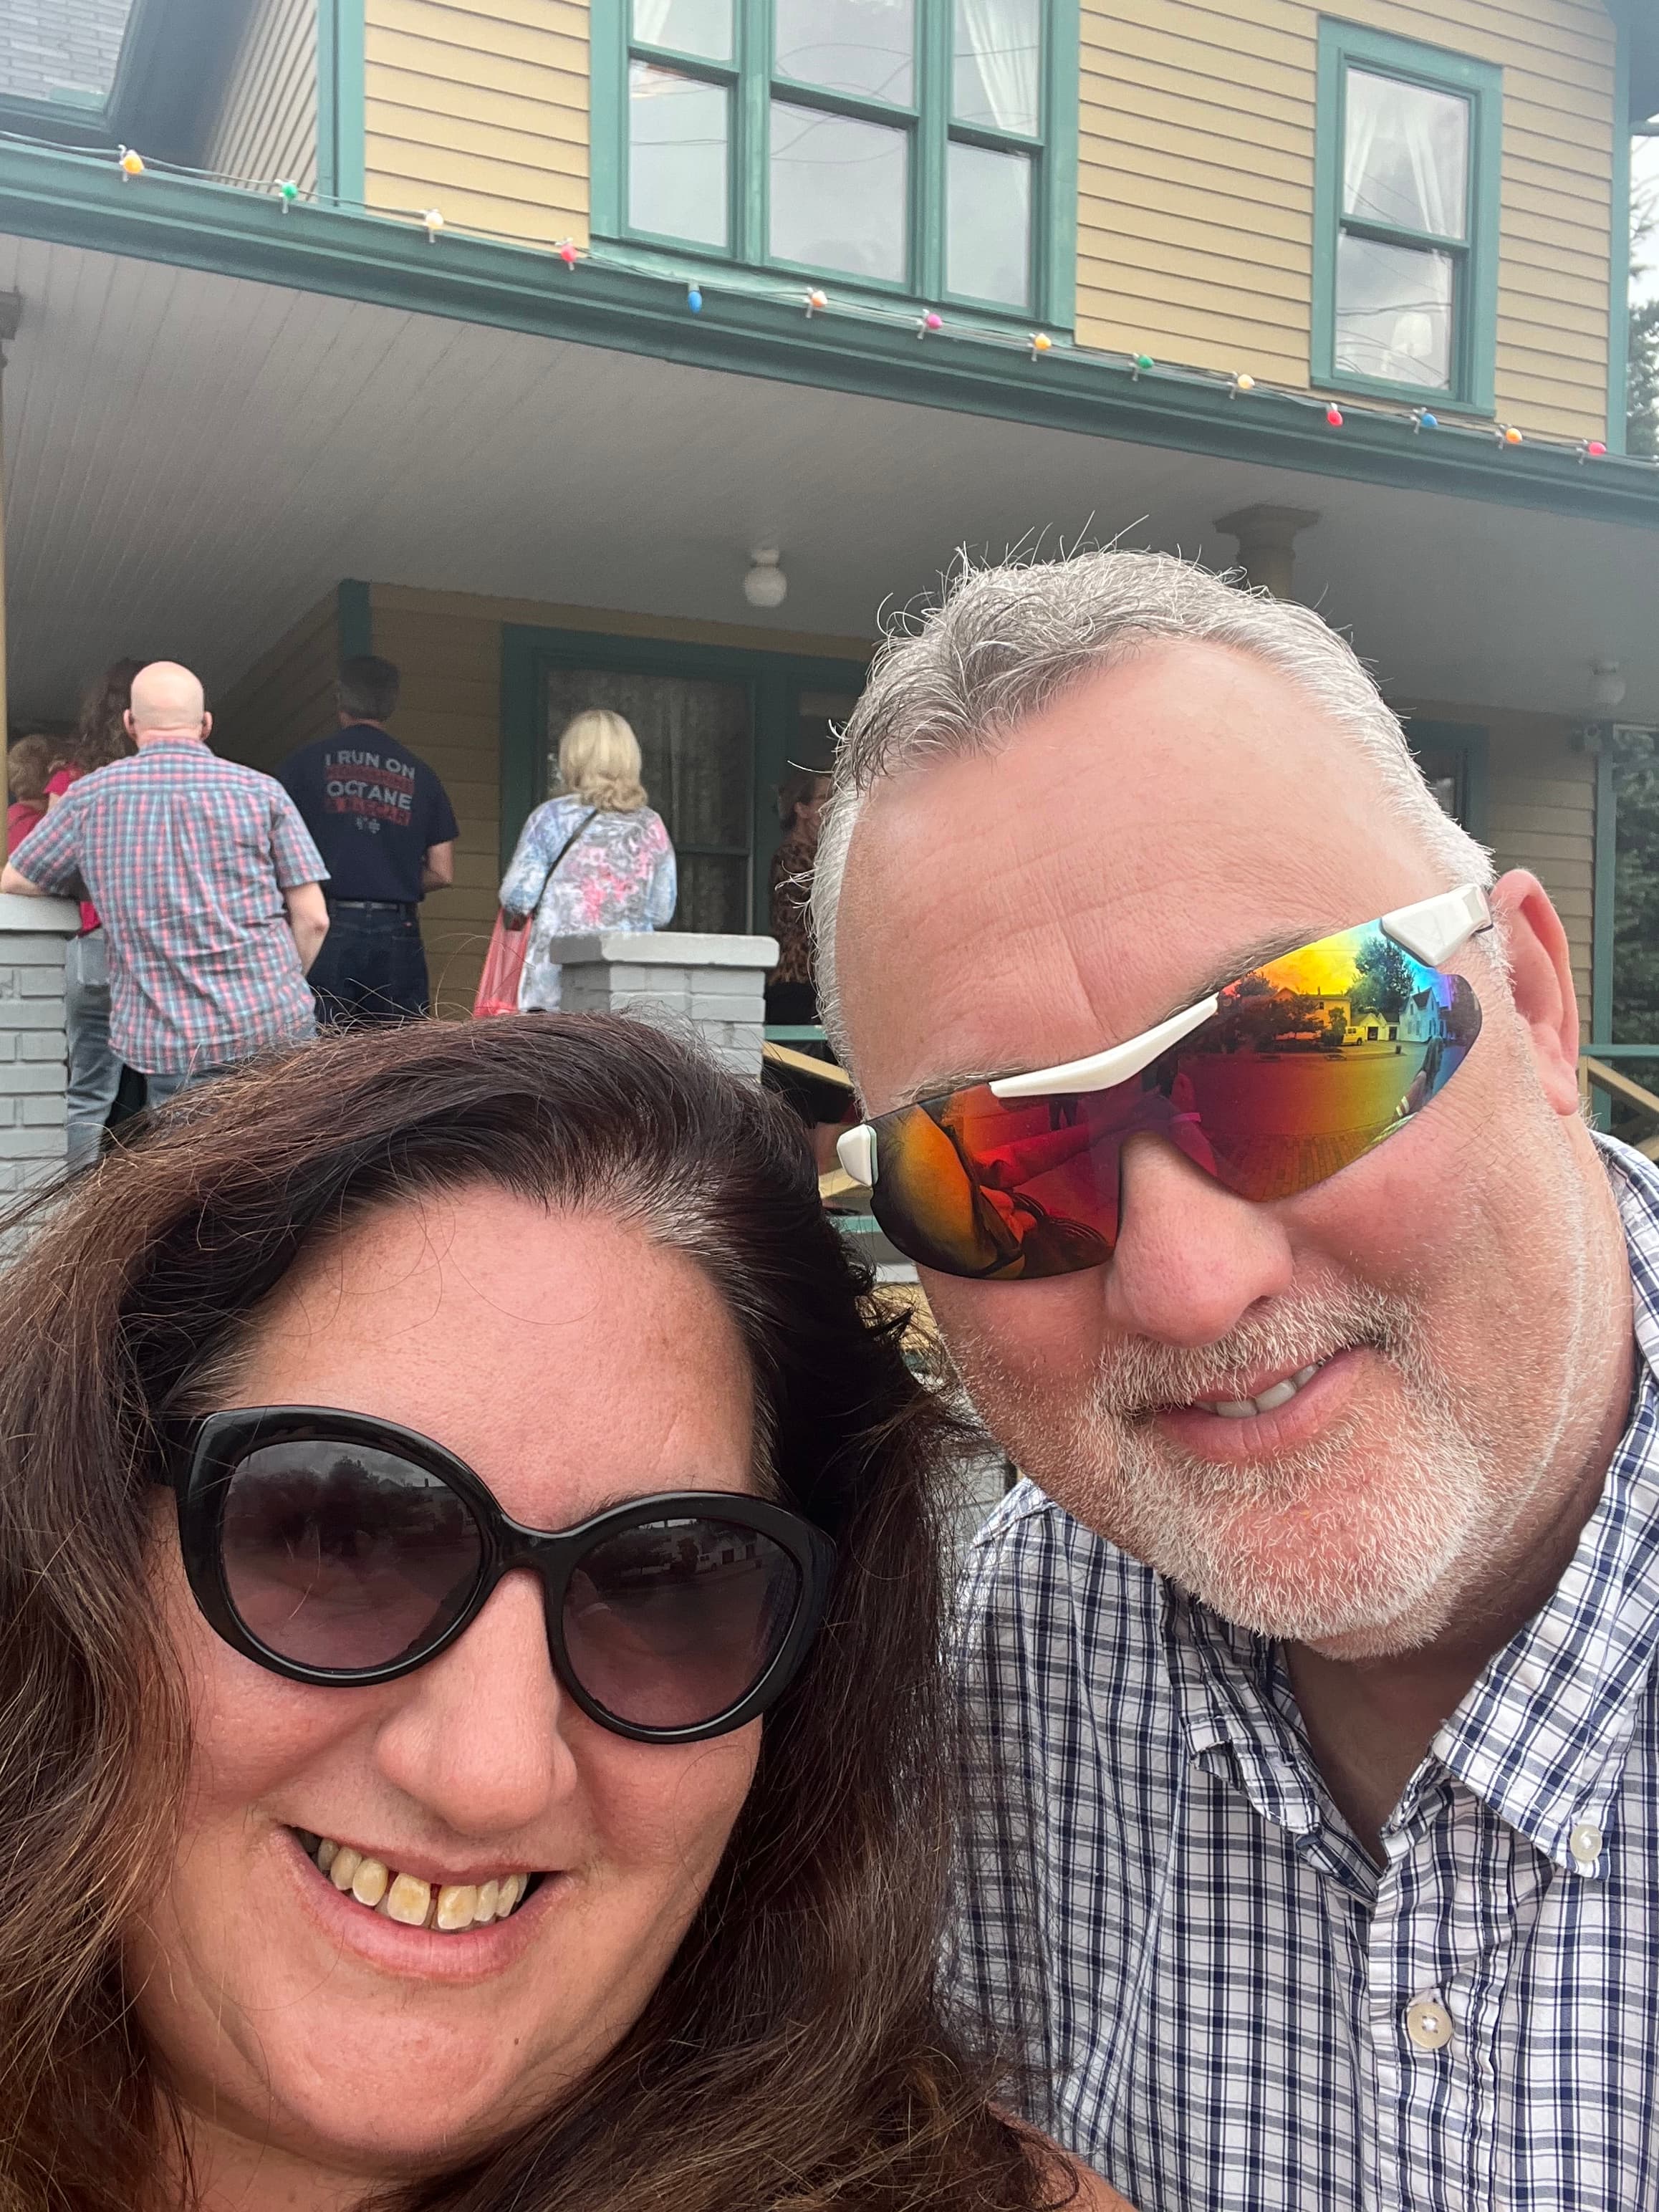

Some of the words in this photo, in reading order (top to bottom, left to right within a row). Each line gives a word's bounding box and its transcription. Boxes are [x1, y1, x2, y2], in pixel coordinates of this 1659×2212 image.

[324, 754, 332, 766] I
[337, 750, 380, 768] RUN
[385, 758, 415, 779] ON
[327, 780, 413, 809] OCTANE
